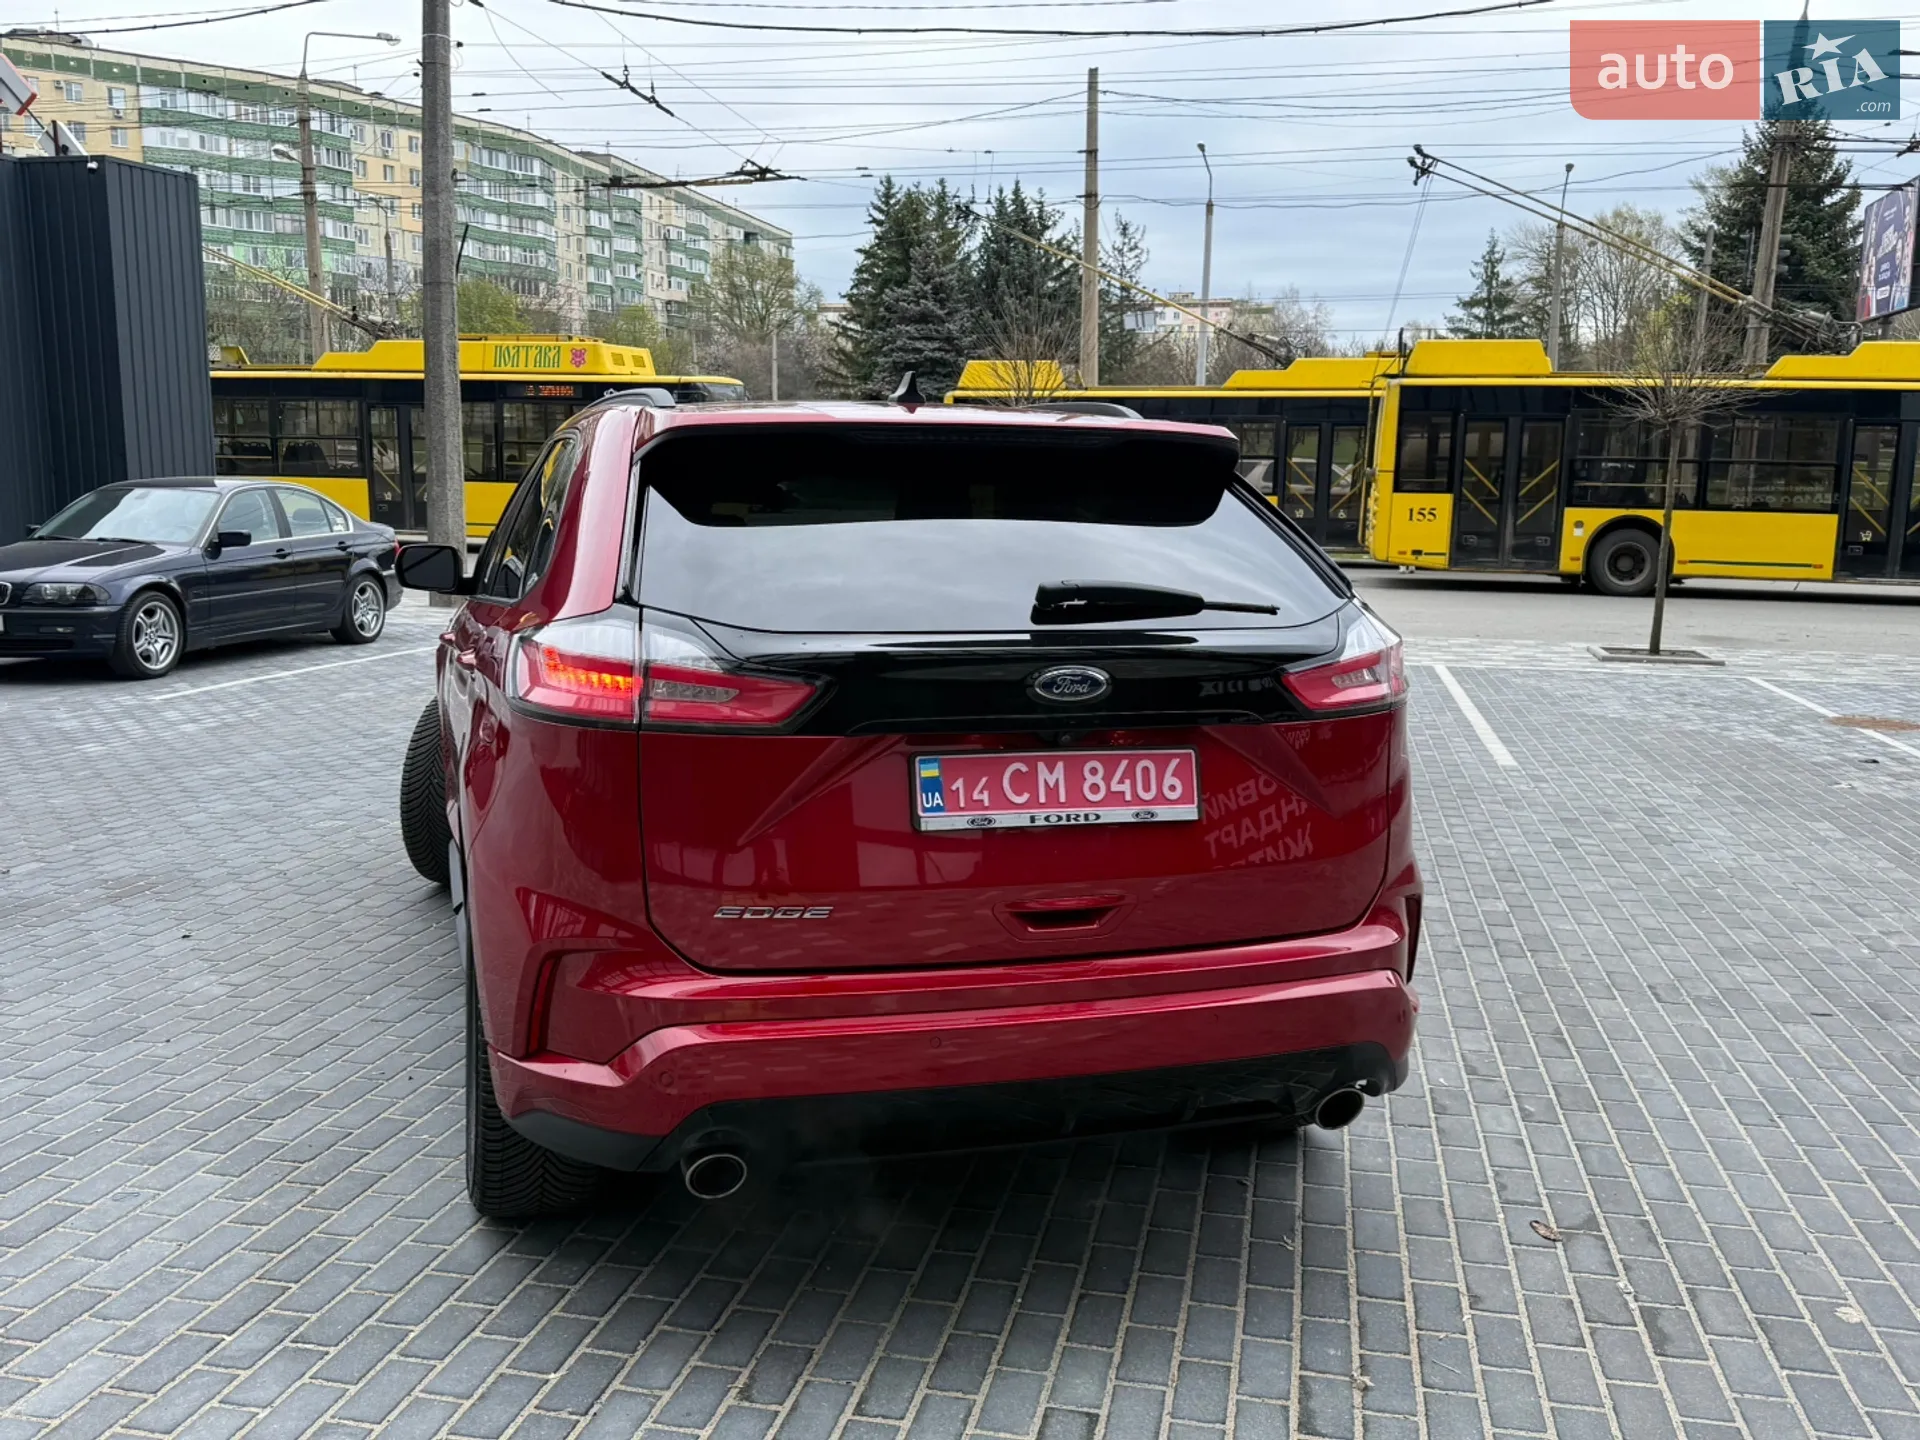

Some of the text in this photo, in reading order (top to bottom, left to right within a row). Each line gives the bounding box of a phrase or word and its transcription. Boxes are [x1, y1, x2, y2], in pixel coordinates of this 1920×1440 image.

[493, 345, 562, 368] ПОЛТАВА
[1408, 507, 1438, 522] 155
[1052, 675, 1092, 694] Ford
[950, 758, 1183, 808] 14 CM 8406
[922, 792, 944, 808] UA
[1029, 812, 1102, 824] FORD
[713, 906, 834, 919] EDGE
